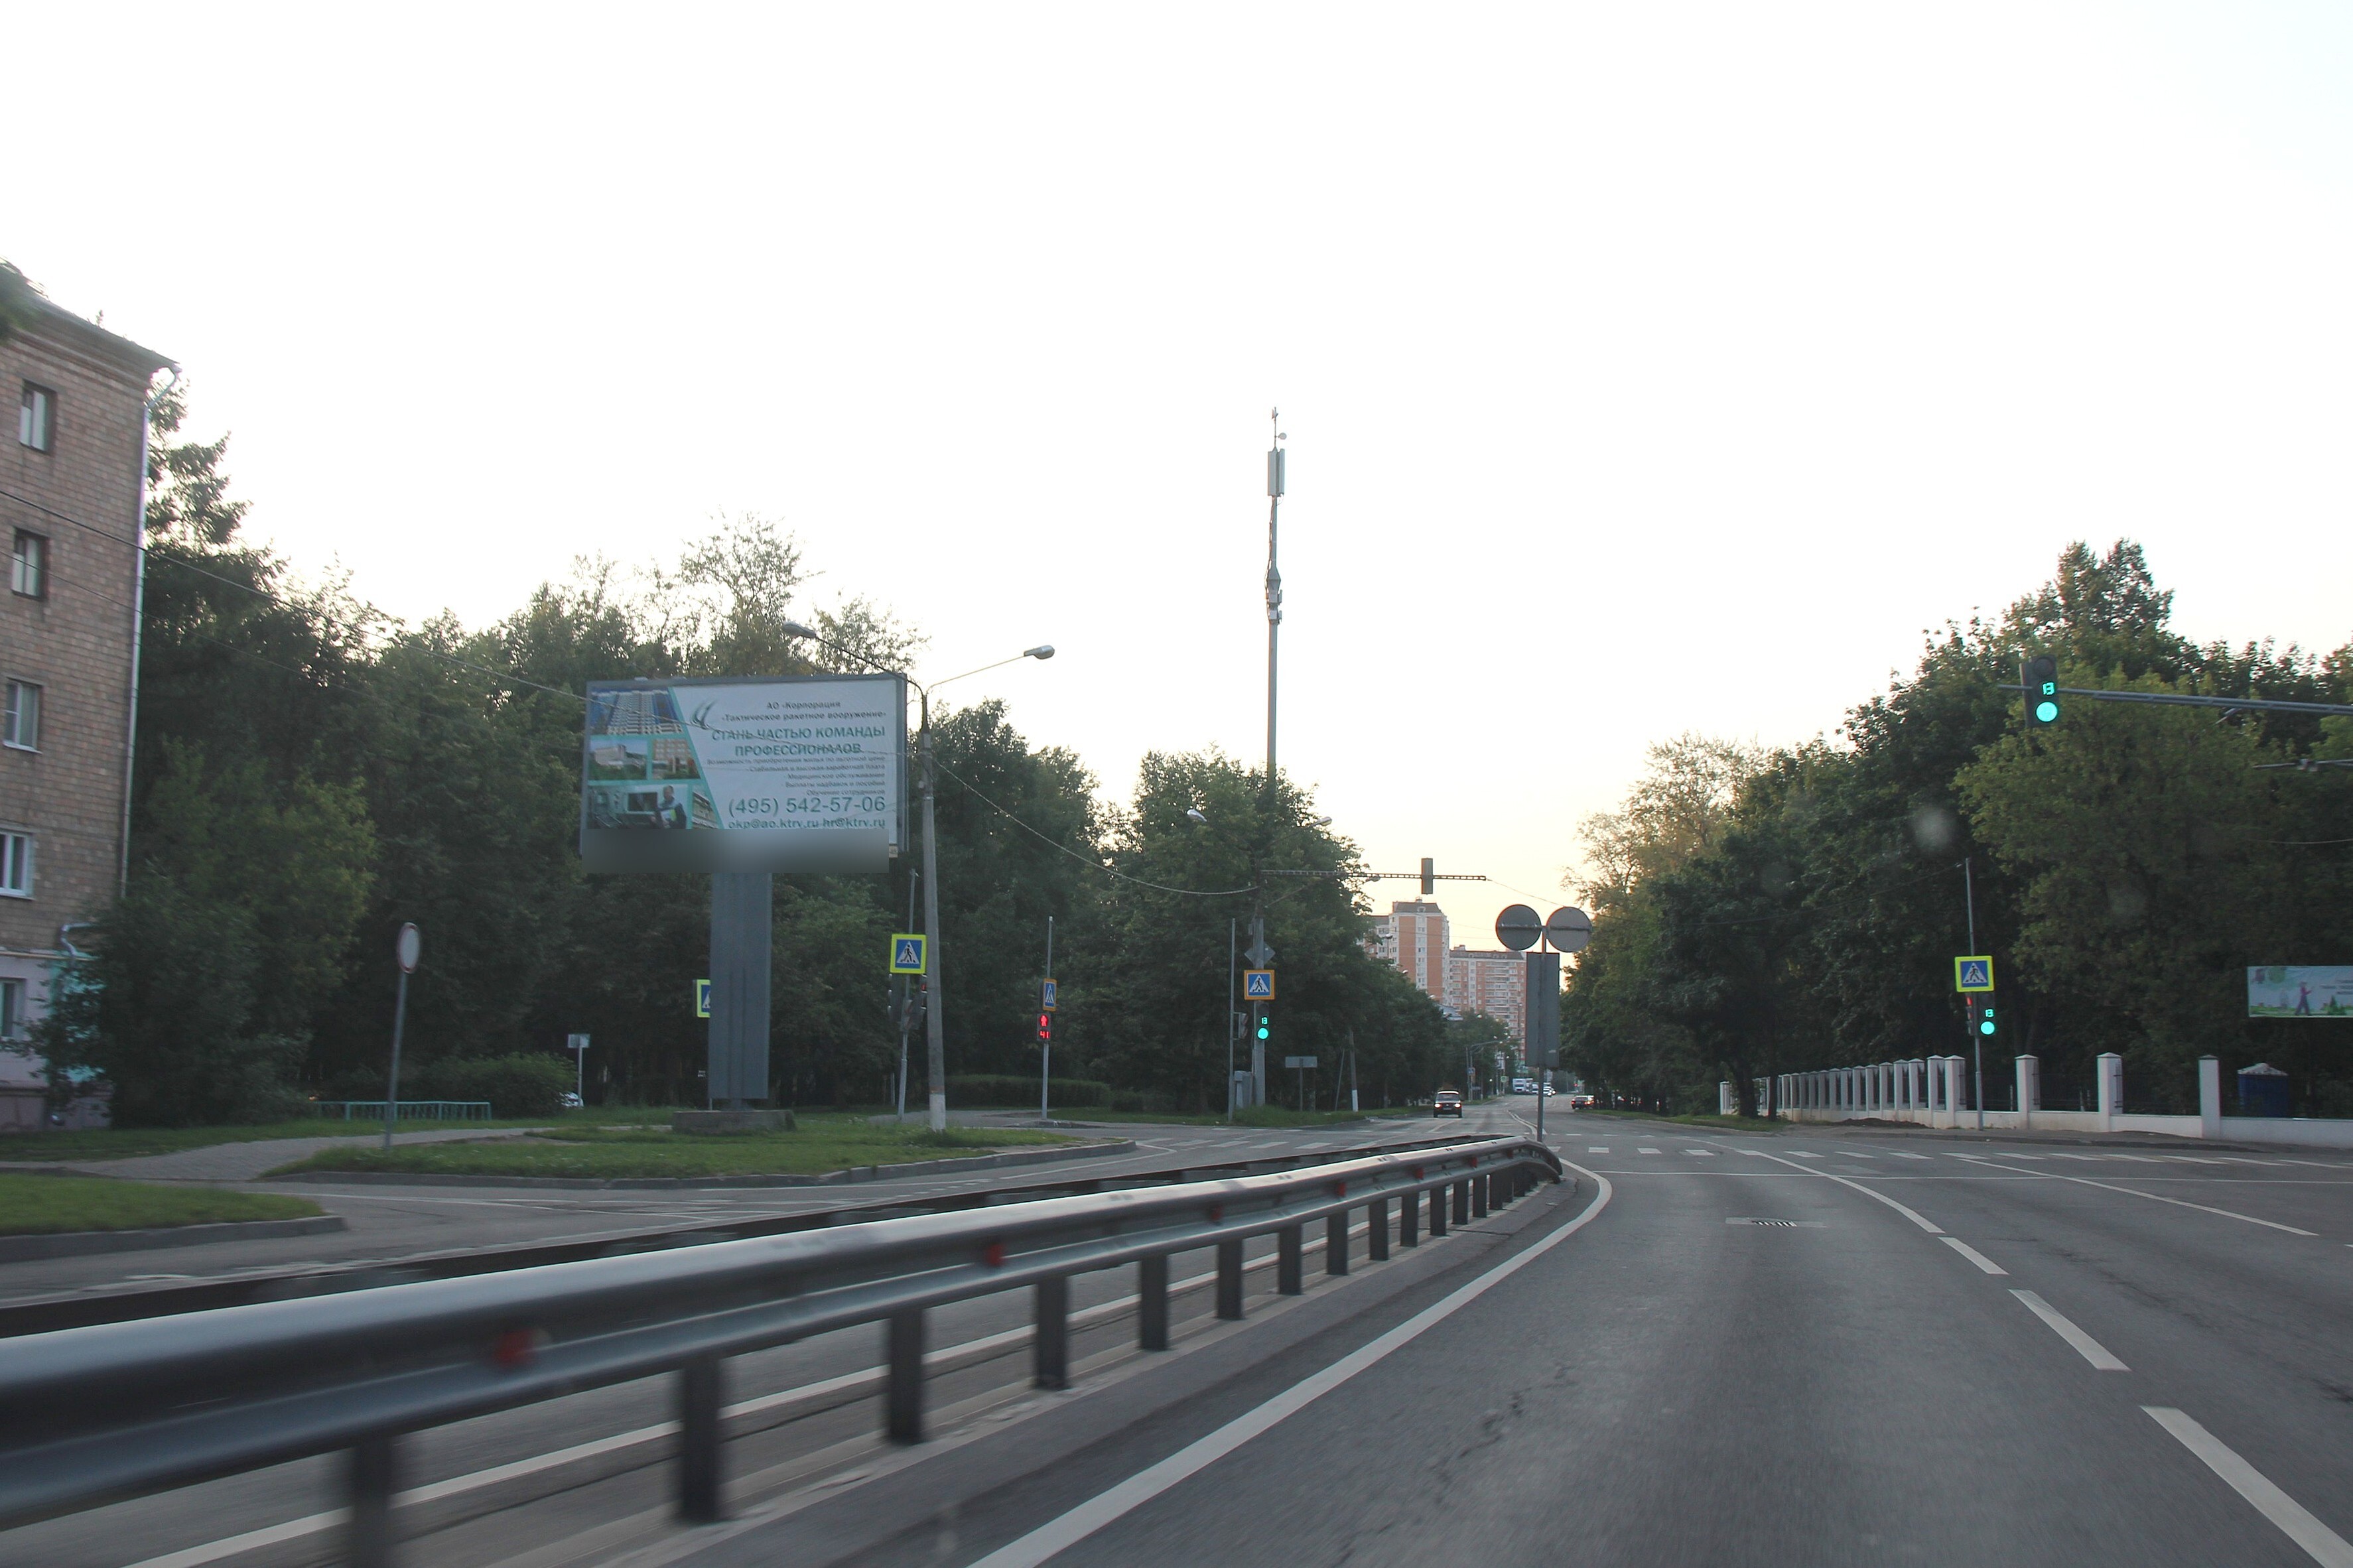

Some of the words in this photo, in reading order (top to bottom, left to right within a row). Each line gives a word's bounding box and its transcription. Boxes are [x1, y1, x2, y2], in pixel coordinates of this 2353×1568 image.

[2043, 682, 2054, 695] 13
[711, 730, 752, 741] СТАНЬ
[757, 728, 812, 740] ЧАСТЬЮ
[815, 726, 886, 739] КОМАНДЫ
[735, 743, 861, 756] ПРОФЕССИОНАЛОВ
[728, 798, 779, 818] (495)
[785, 796, 886, 813] 542-57-06
